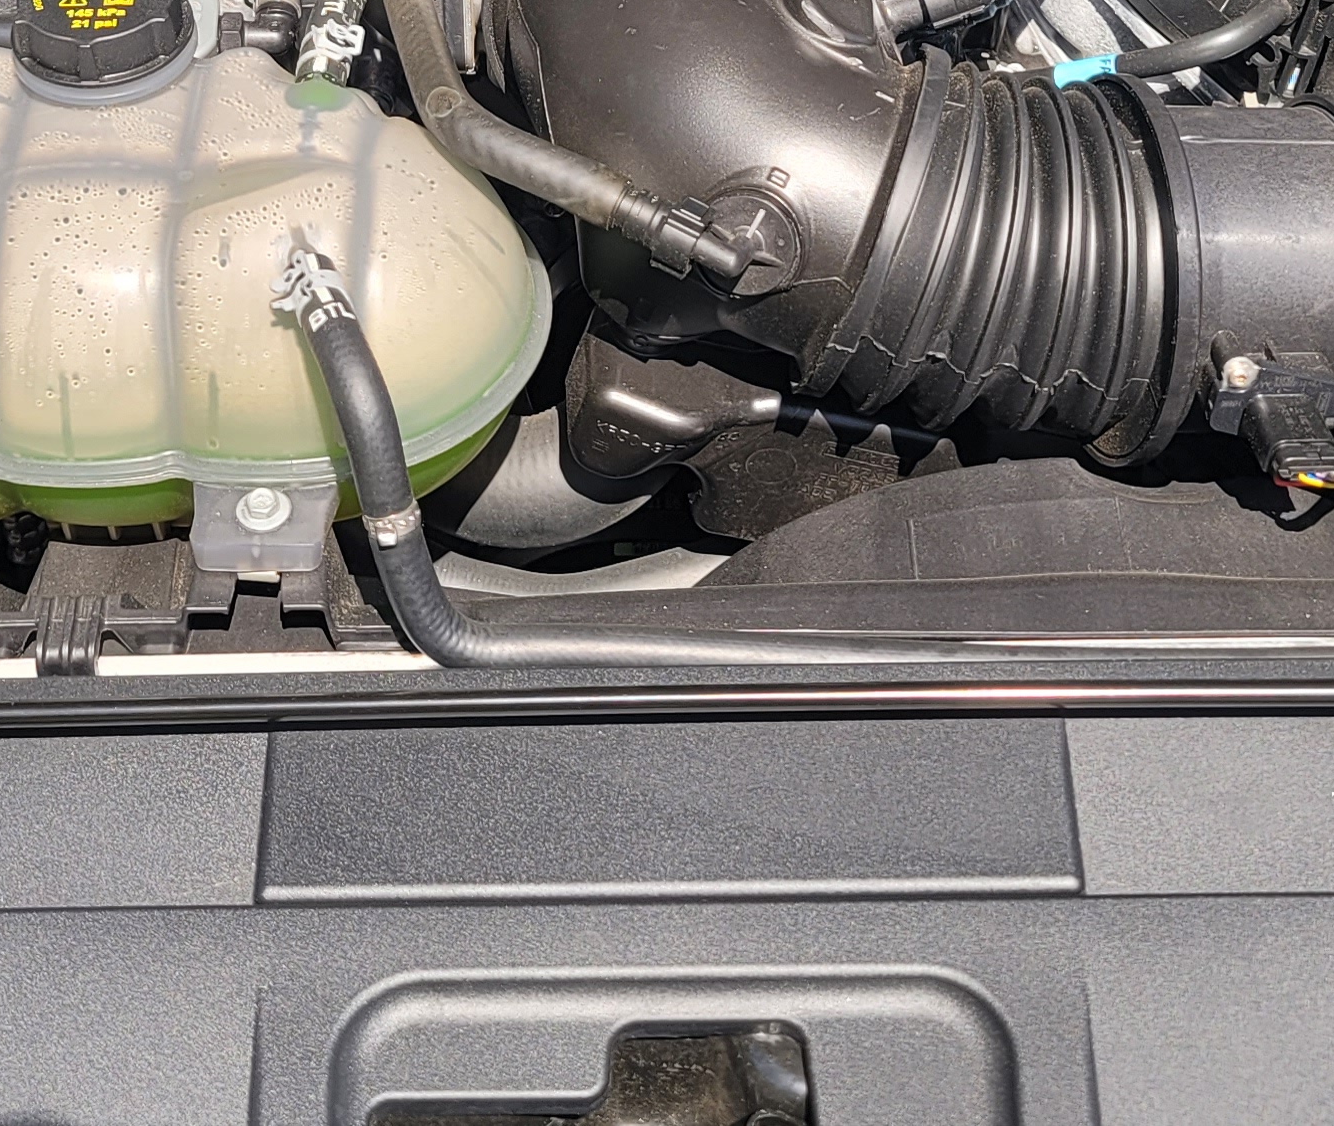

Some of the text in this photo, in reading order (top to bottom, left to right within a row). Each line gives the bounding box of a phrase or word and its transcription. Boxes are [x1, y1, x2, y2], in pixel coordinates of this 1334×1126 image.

[66, 7, 127, 18] 145 kPa
[71, 18, 90, 29] 21
[308, 301, 357, 333] BTL
